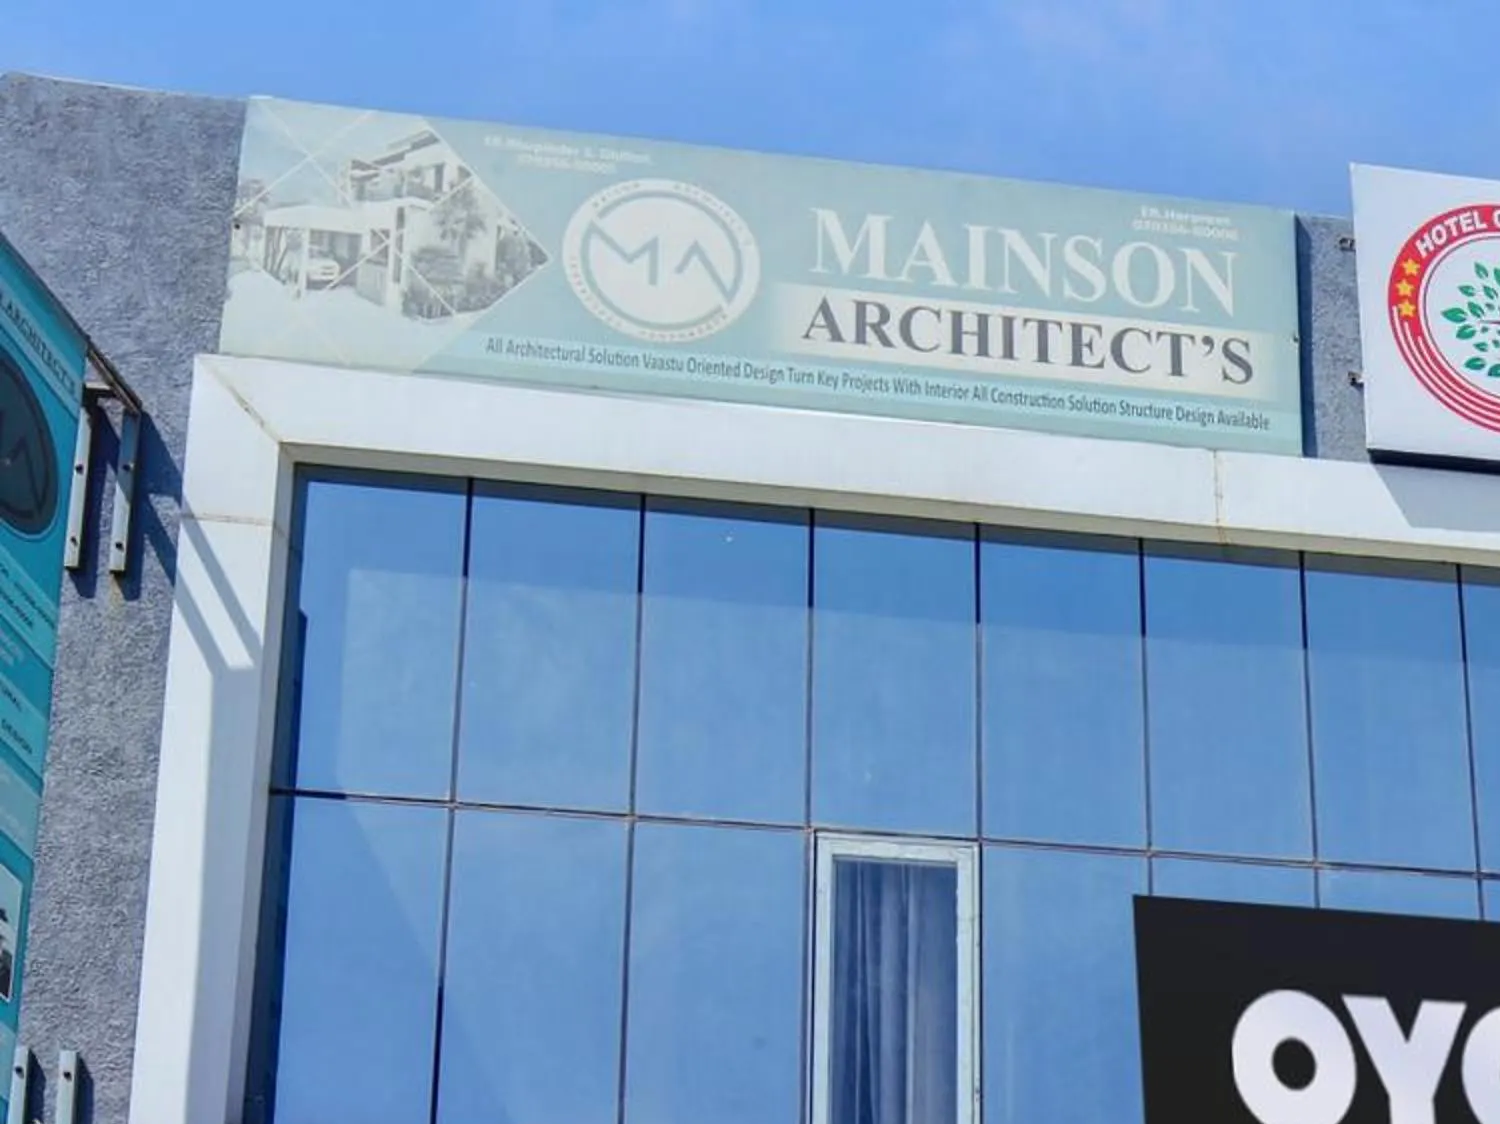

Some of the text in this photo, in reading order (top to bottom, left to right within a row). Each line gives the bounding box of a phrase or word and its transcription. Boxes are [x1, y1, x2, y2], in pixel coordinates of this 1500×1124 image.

[809, 207, 1238, 318] MAINSON
[1415, 211, 1487, 258] HOTEL
[486, 337, 1270, 431] All Architectural Solution Vaastu Oriented Design Turn Key Projects With Interior All Construction Solution Structure Design Available
[803, 296, 1254, 386] ARCHITECT'S
